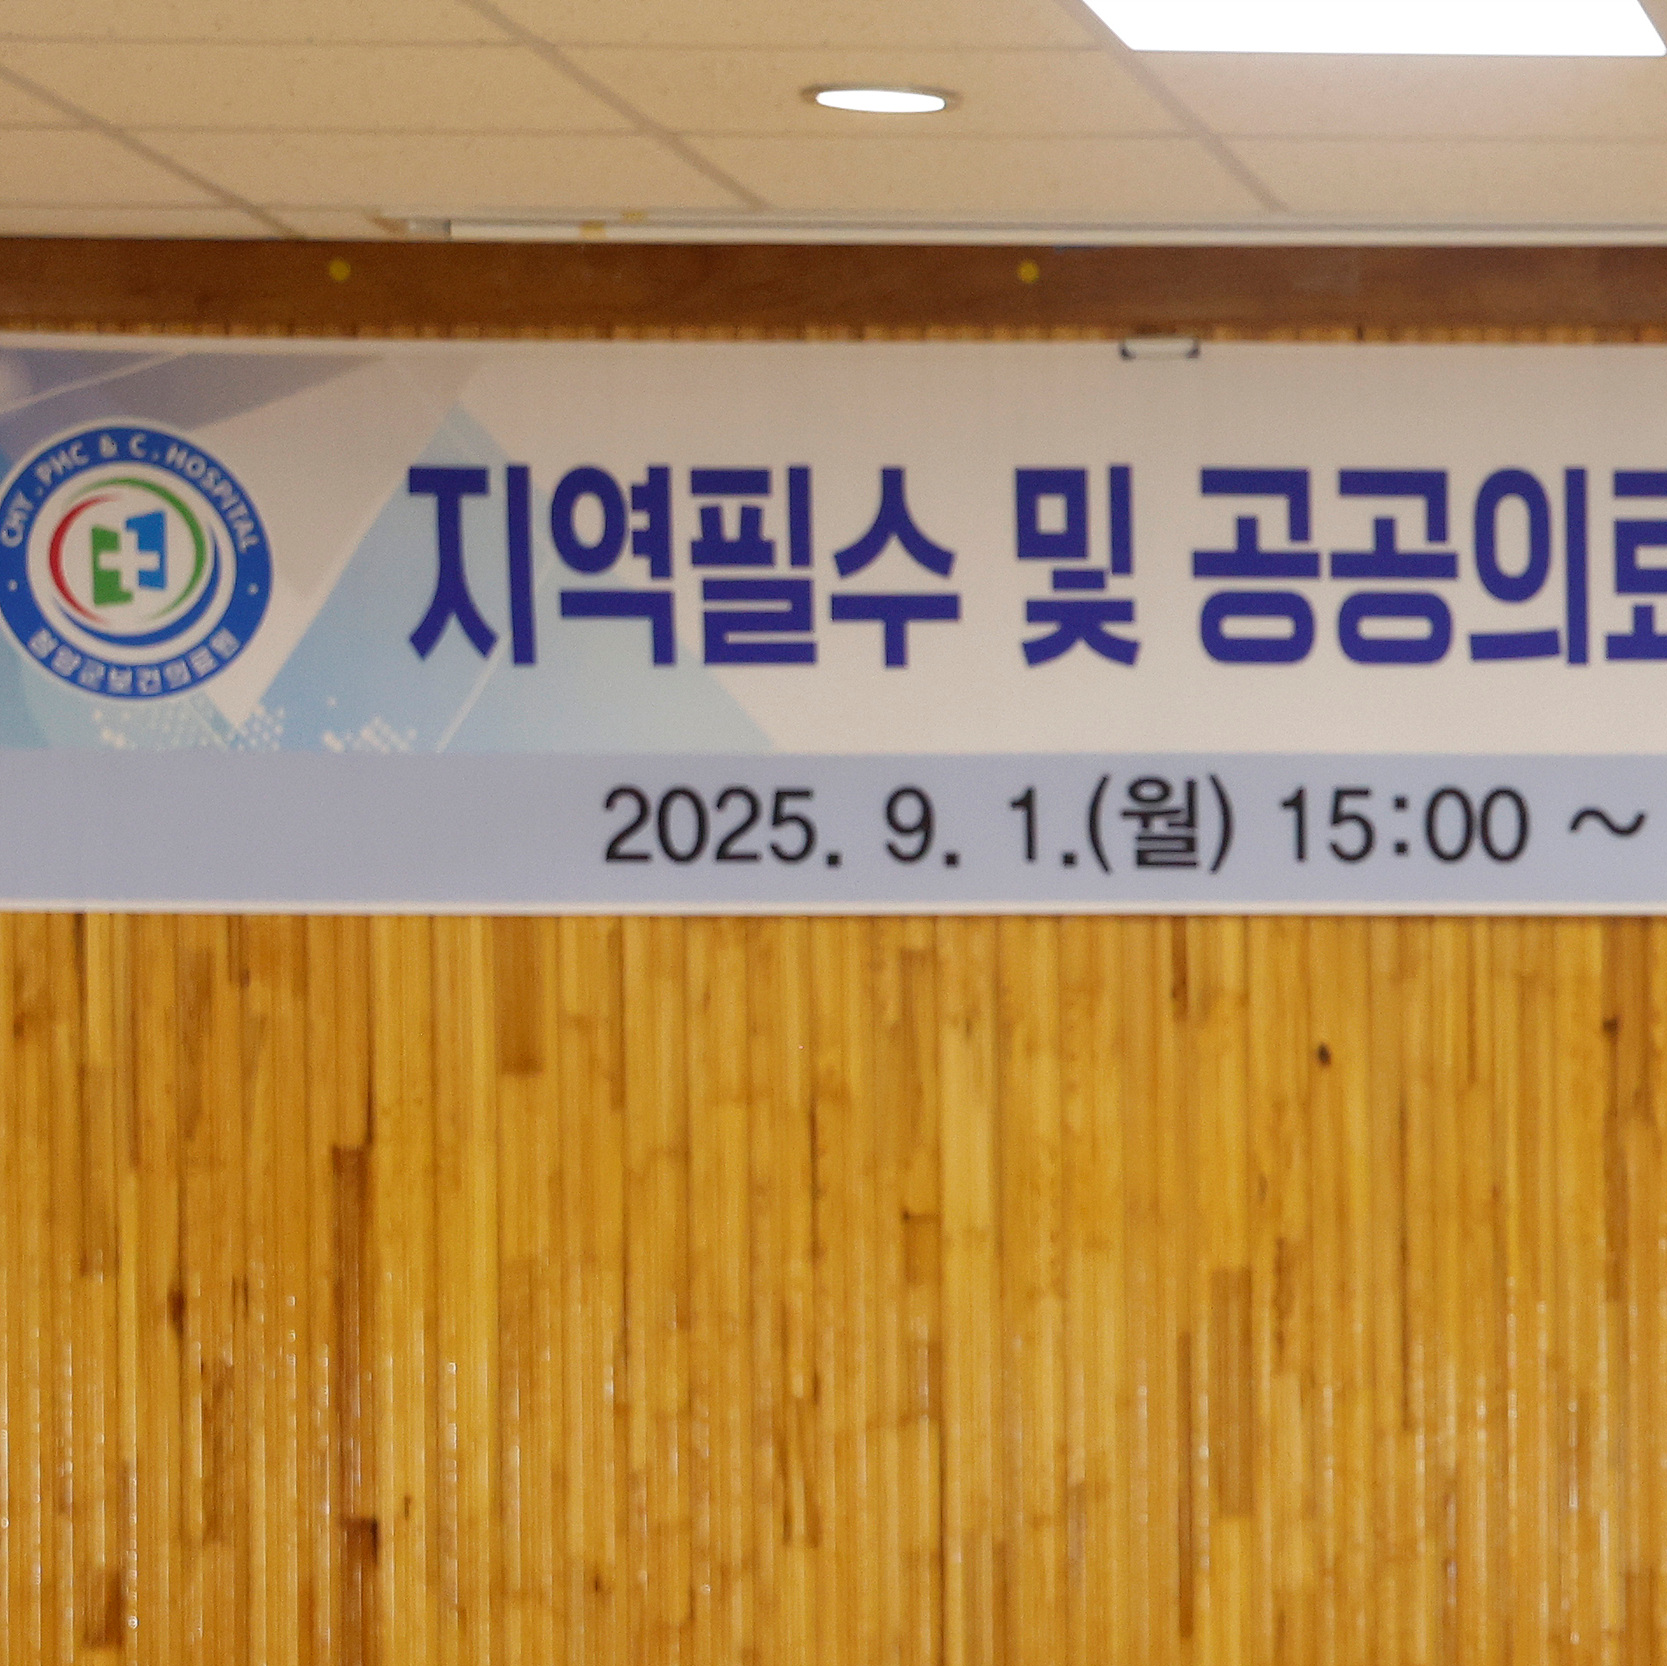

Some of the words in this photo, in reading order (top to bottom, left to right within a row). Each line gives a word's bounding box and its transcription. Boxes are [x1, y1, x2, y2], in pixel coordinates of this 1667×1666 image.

[165, 443, 261, 555] HOSPITAL
[409, 466, 960, 667] 지역필수
[1016, 466, 1139, 666] 및
[602, 783, 843, 869] 2025.
[883, 785, 961, 869] 9.
[1009, 773, 1235, 874] 1.(월)
[1280, 785, 1531, 865] 15:00
